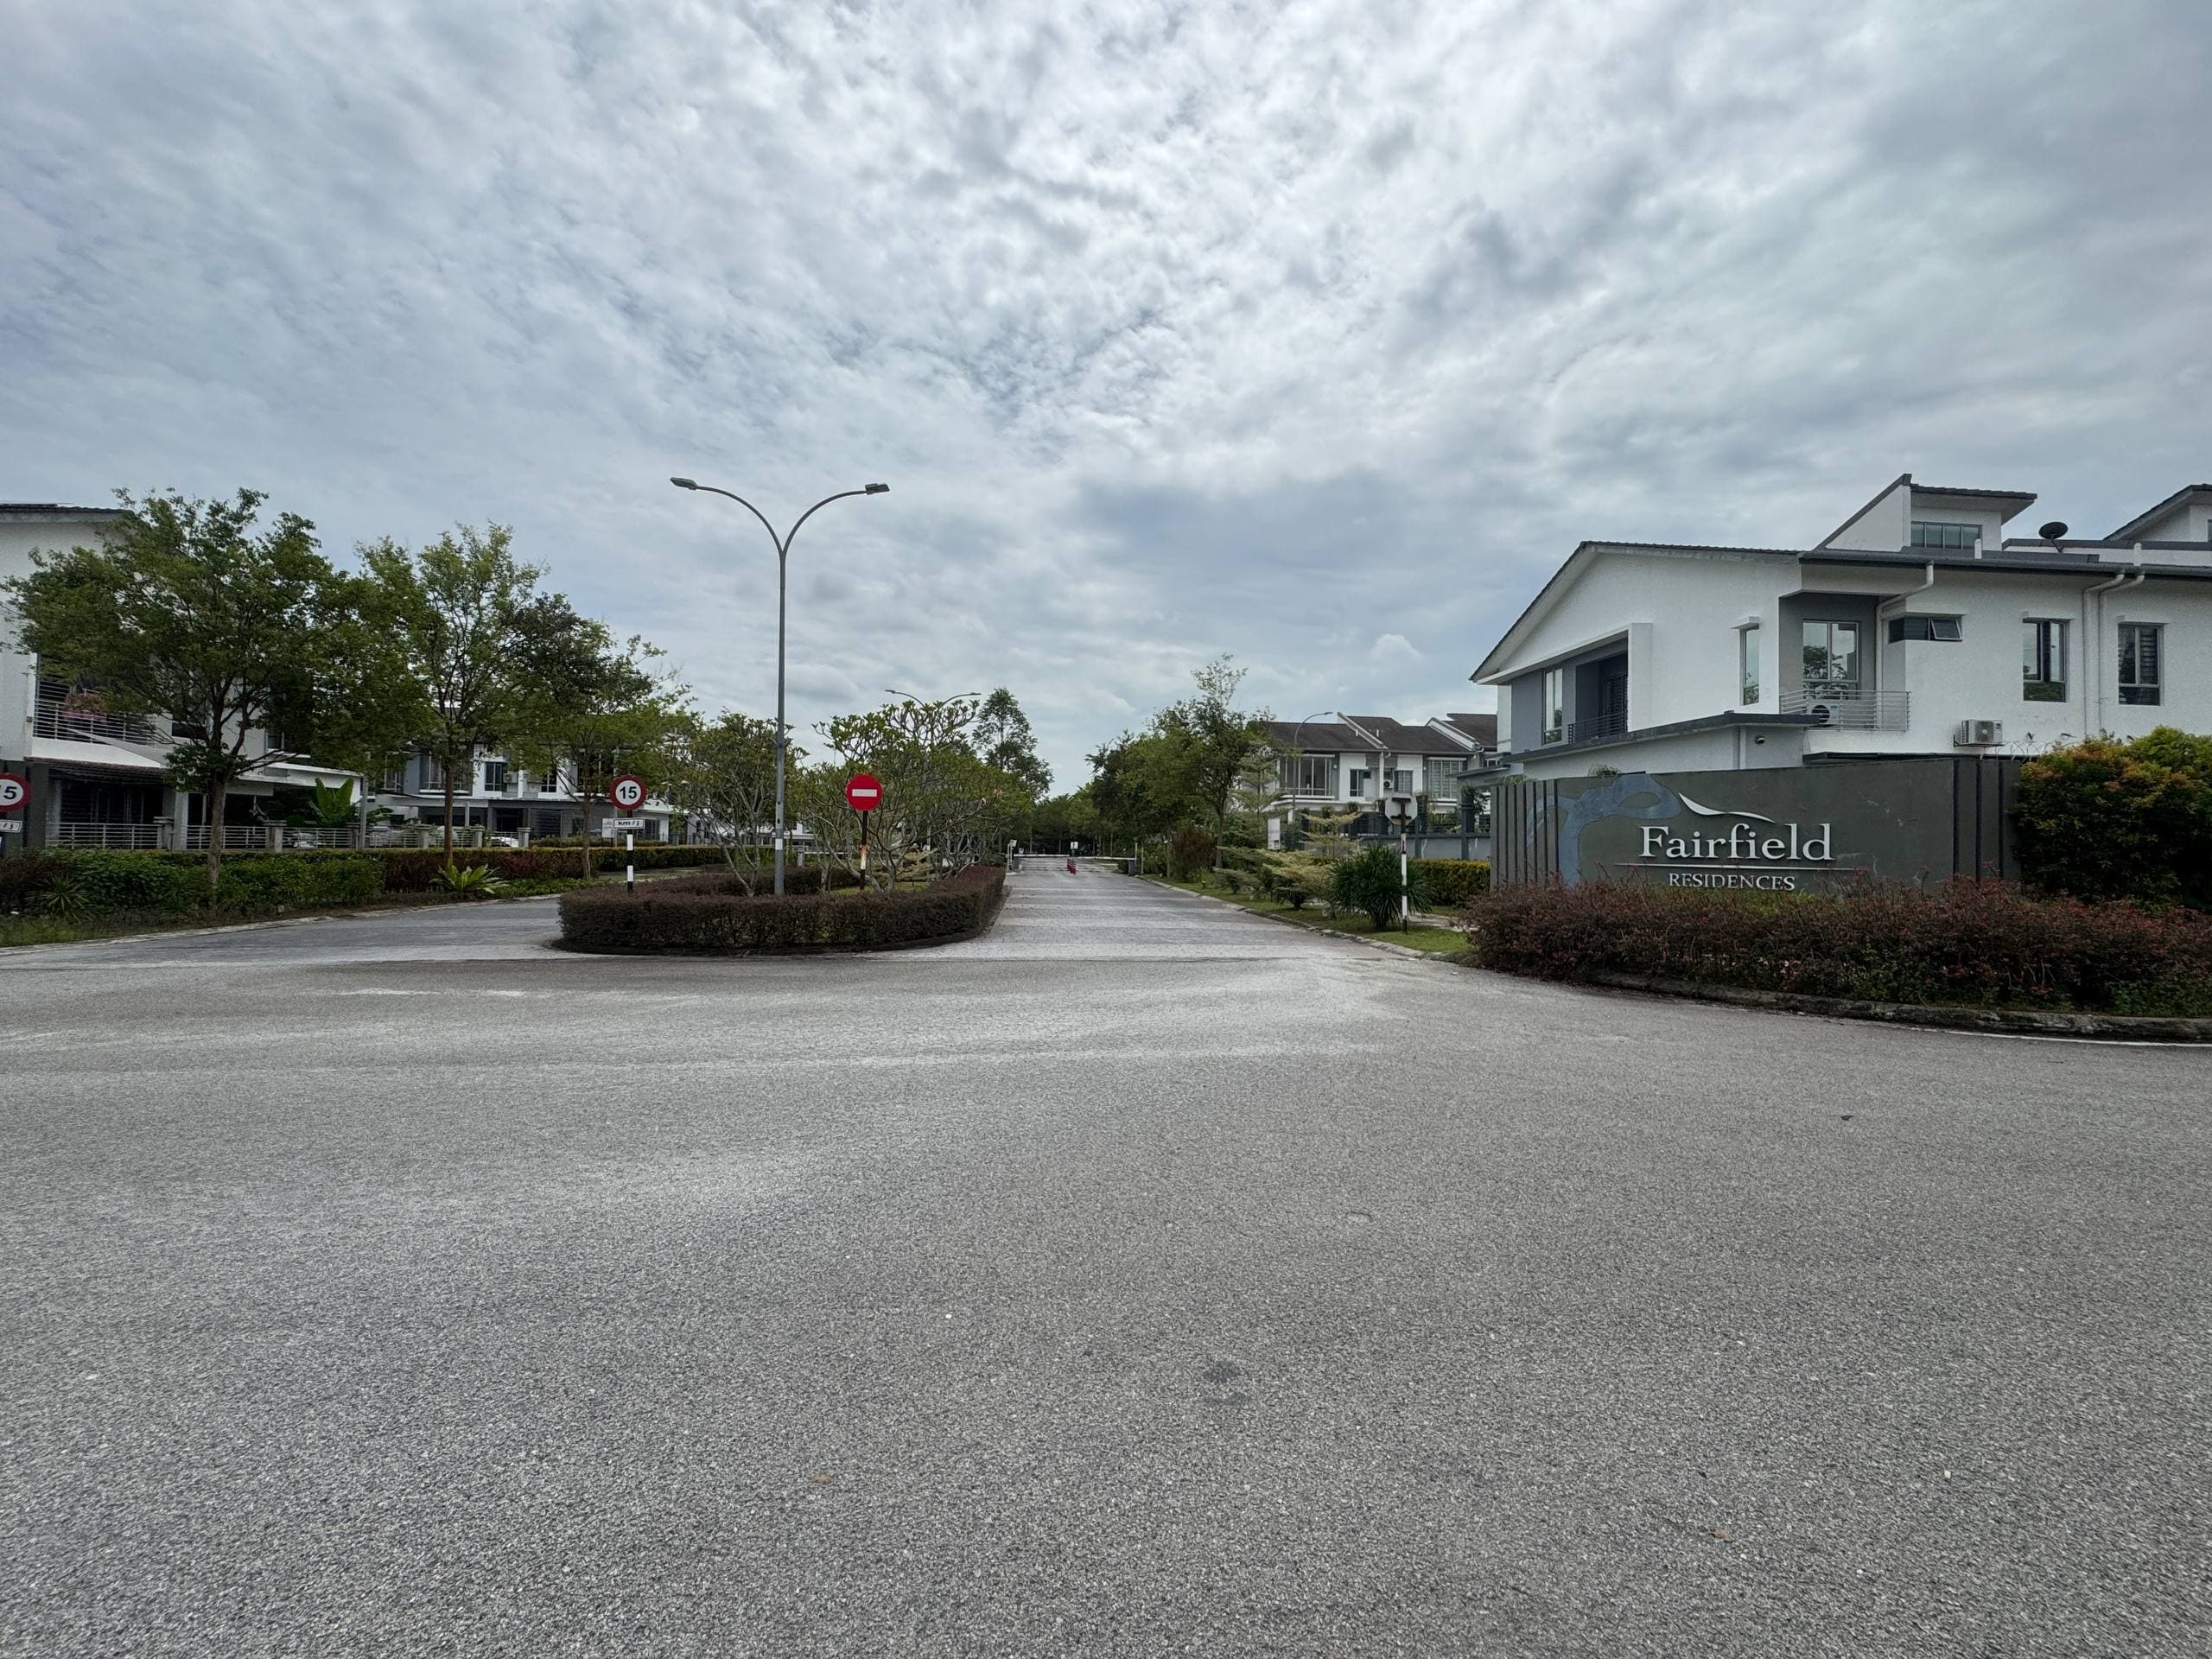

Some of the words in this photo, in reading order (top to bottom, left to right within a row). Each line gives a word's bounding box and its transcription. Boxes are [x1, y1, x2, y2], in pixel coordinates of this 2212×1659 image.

[0, 785, 17, 799] 5
[620, 786, 637, 799] 15
[1638, 823, 1835, 861] Fairfield
[1669, 873, 1796, 891] RESIDENCES
